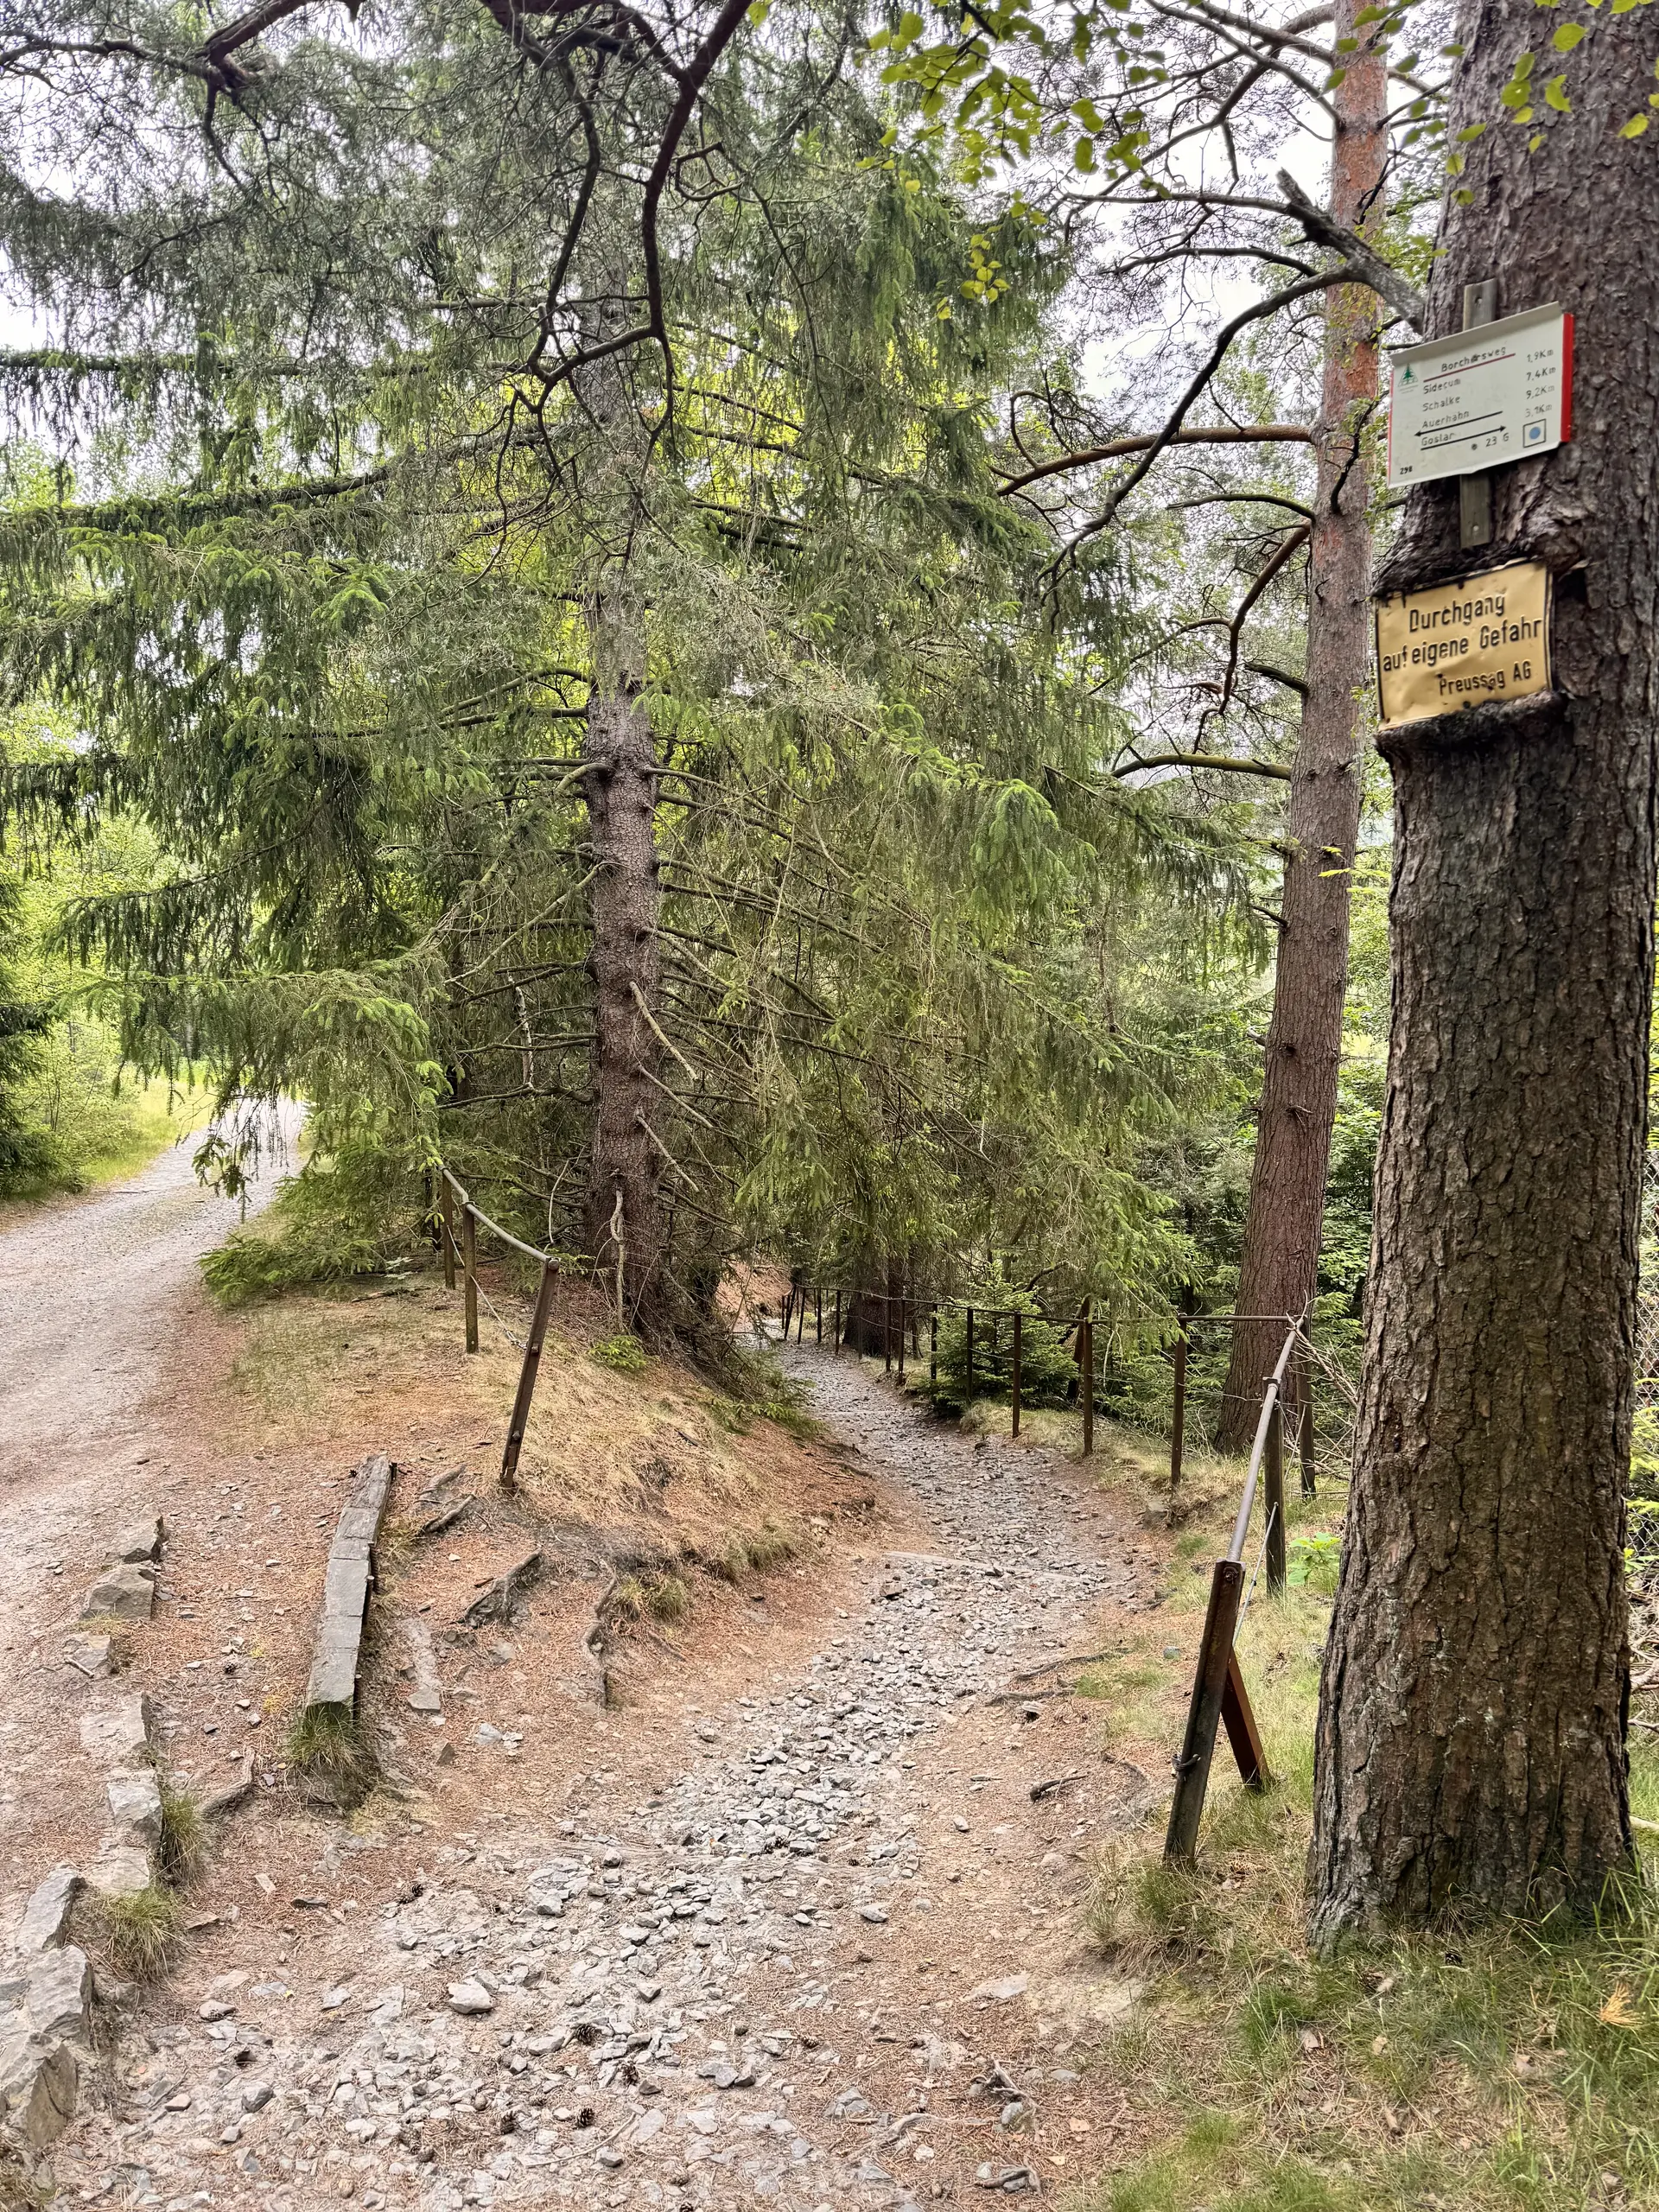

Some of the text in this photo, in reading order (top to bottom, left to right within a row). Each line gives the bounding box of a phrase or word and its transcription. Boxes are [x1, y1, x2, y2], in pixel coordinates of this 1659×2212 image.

[1422, 395, 1460, 412] Schalke
[1421, 410, 1470, 429] Auerhahn
[1421, 432, 1456, 446] Goslar
[1409, 594, 1505, 632] Durchgang
[1383, 615, 1542, 671] auf eigene Gefahr
[1439, 659, 1532, 696] Preussag AG
